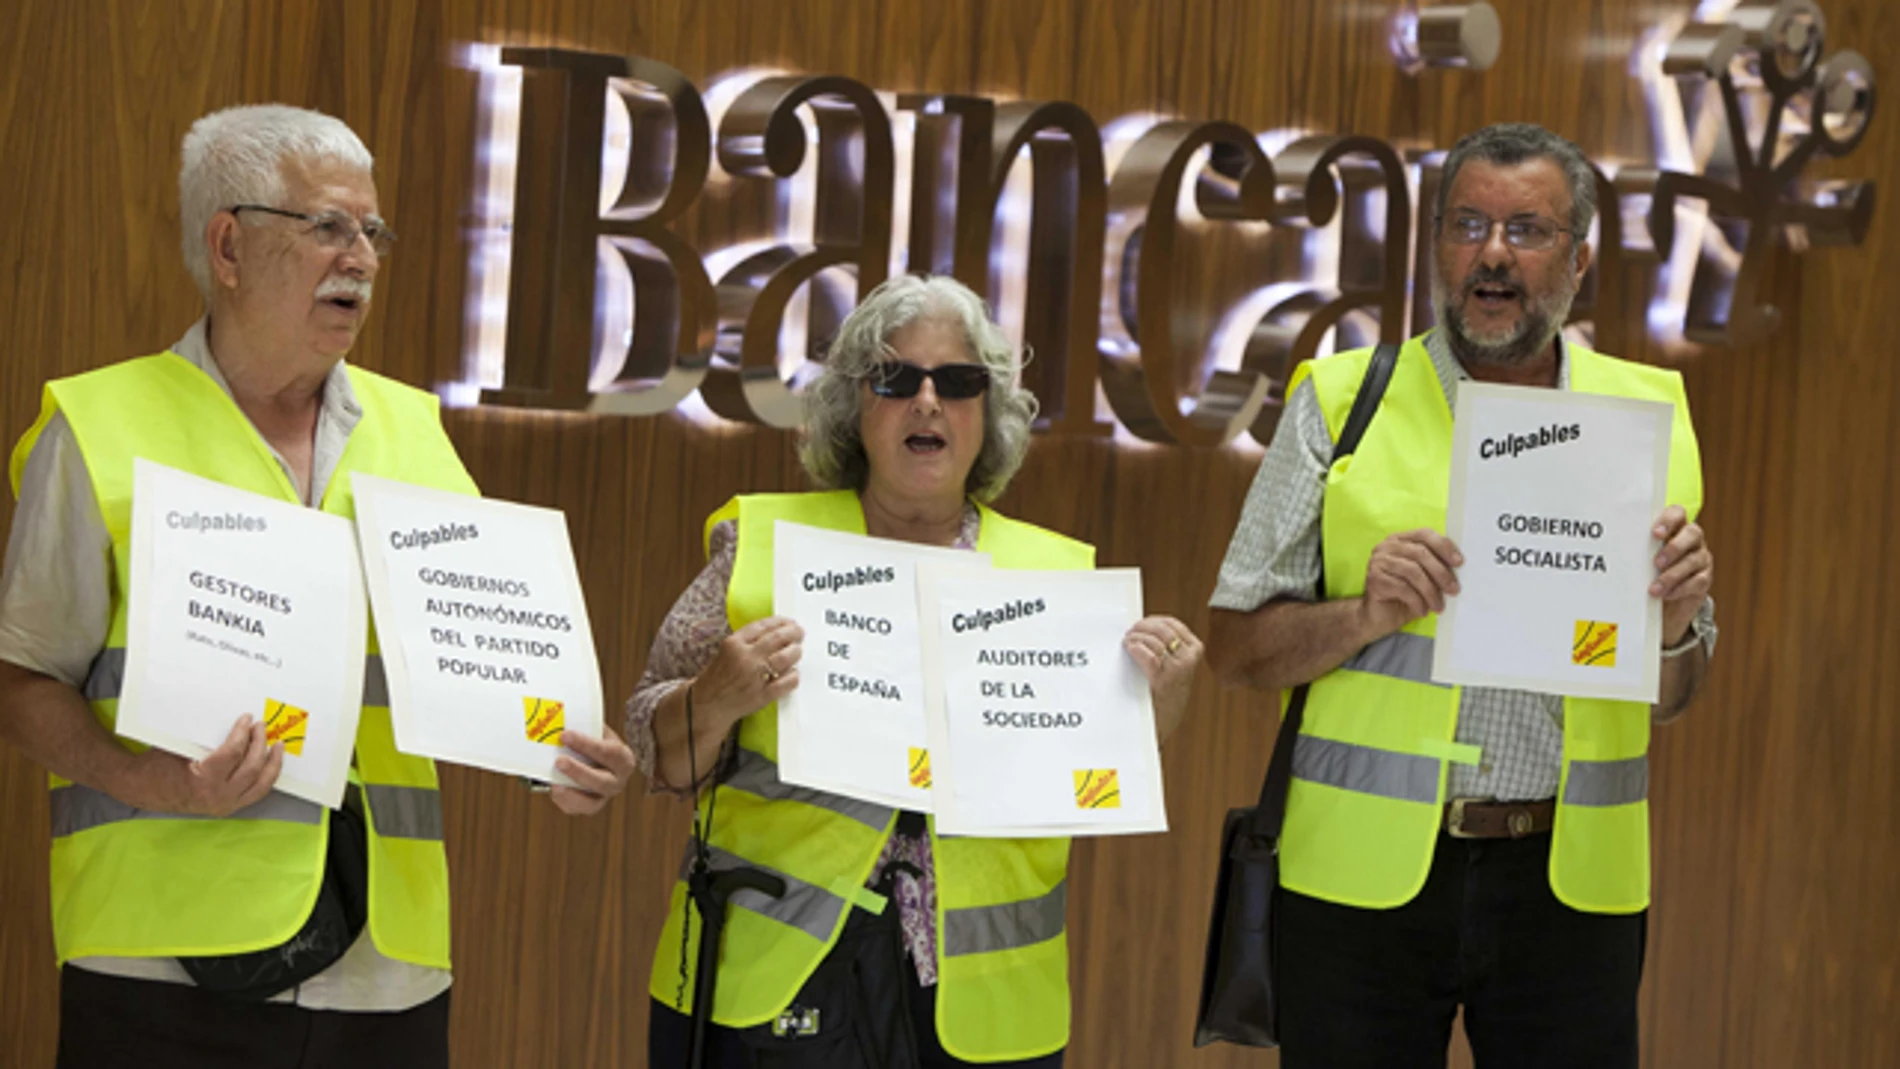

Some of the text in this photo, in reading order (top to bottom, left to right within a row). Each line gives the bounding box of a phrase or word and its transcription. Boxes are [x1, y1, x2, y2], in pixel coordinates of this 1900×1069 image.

[478, 2, 1658, 448] Banca
[1479, 423, 1581, 460] Culpables
[166, 510, 268, 532] Culpables
[1497, 513, 1604, 539] GOBIERNO
[390, 522, 479, 551] Culpables
[1494, 546, 1607, 573] SOCIALISTA
[188, 570, 293, 615] GESTORES
[418, 566, 531, 598] GOBIERNOS
[802, 564, 895, 593] Culpables
[187, 600, 266, 638] BANKIA
[424, 598, 573, 634] AUTONÓMICOS
[824, 609, 893, 636] BANCO
[951, 598, 1046, 634] Culpables
[430, 627, 561, 661] DEL PARTIDO
[827, 640, 851, 660] DE
[976, 648, 1089, 668] AUDITORES
[437, 656, 528, 685] POPULAR
[827, 672, 902, 702] ESPAÑA
[980, 680, 1036, 700] DE LA
[982, 709, 1084, 730] SOCIEDAD
